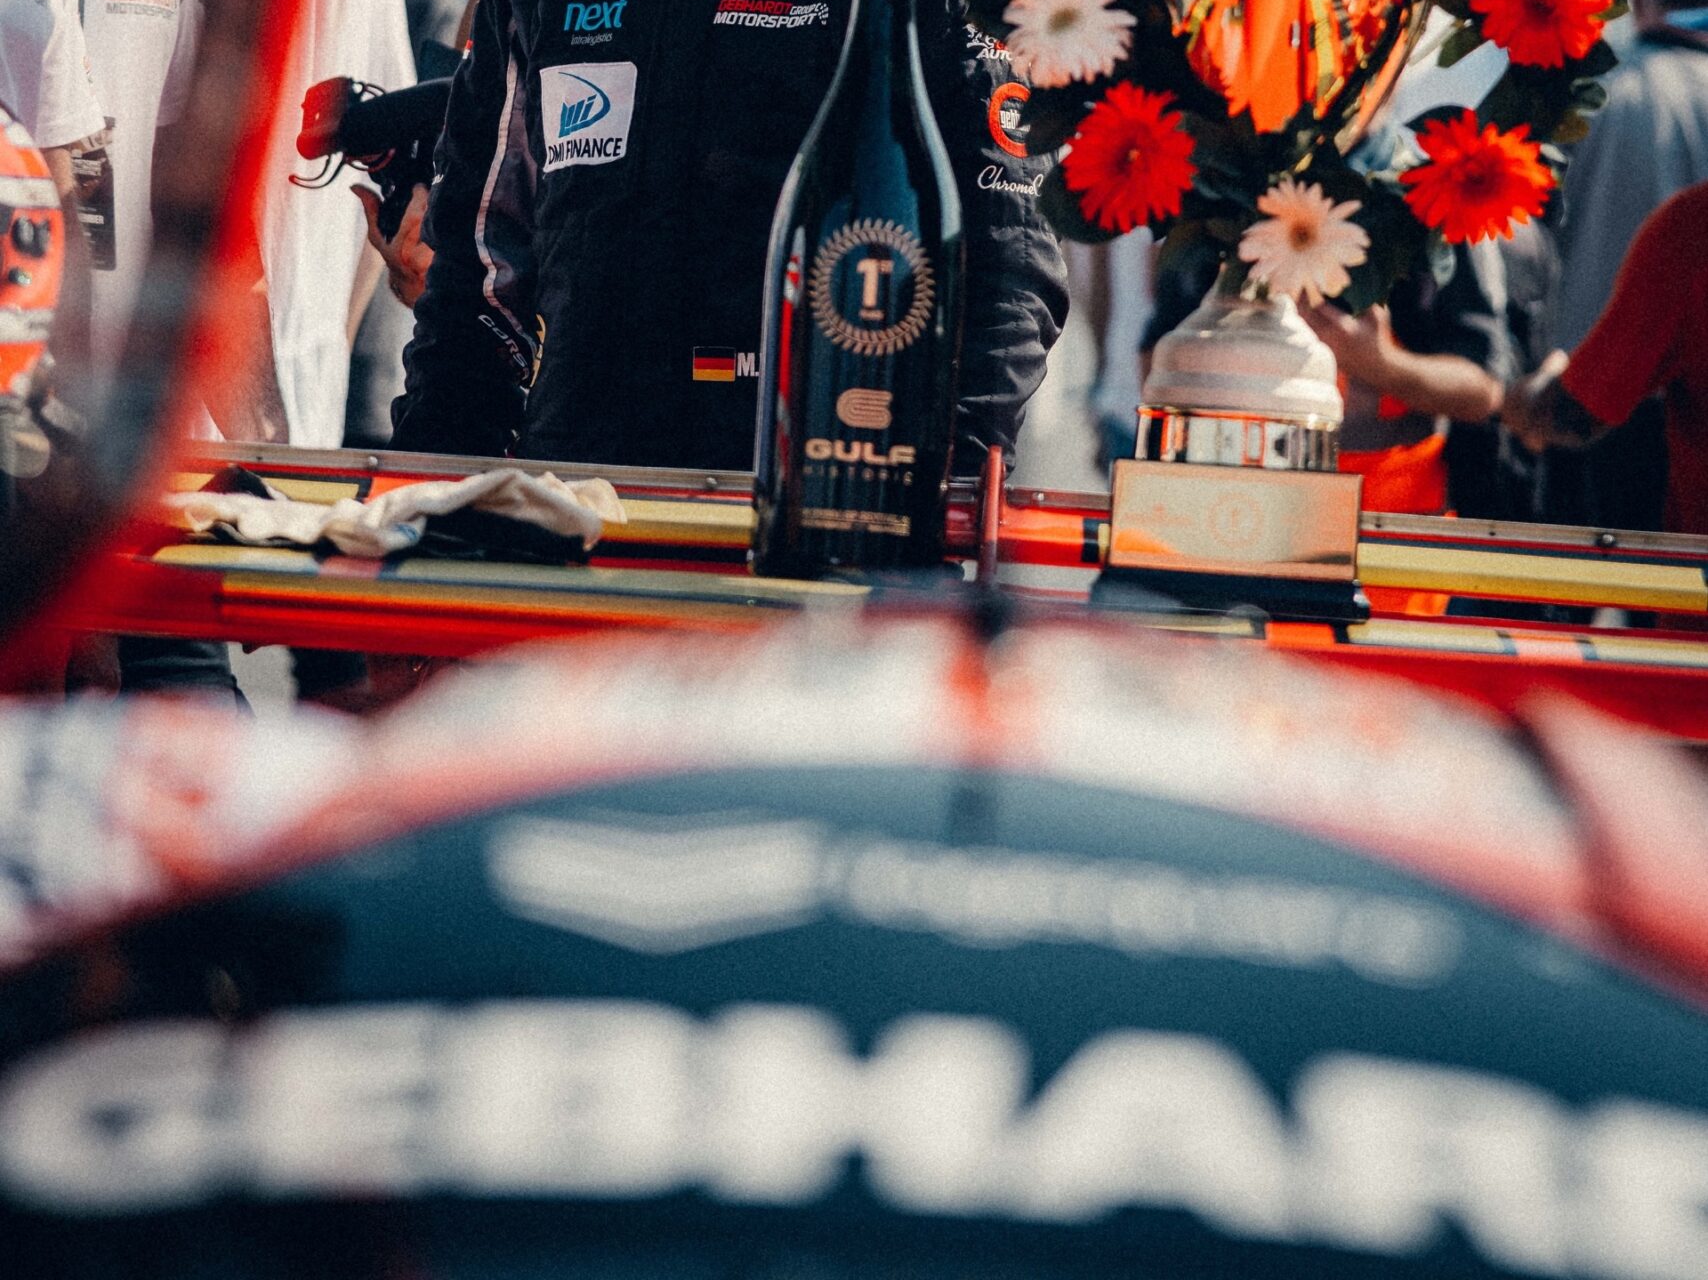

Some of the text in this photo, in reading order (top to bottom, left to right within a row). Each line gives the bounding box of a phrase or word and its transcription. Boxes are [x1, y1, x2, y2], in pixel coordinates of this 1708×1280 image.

[713, 11, 817, 28] MOTORSPORT
[548, 137, 623, 165] DMI FINANCE
[804, 437, 917, 466] GULF
